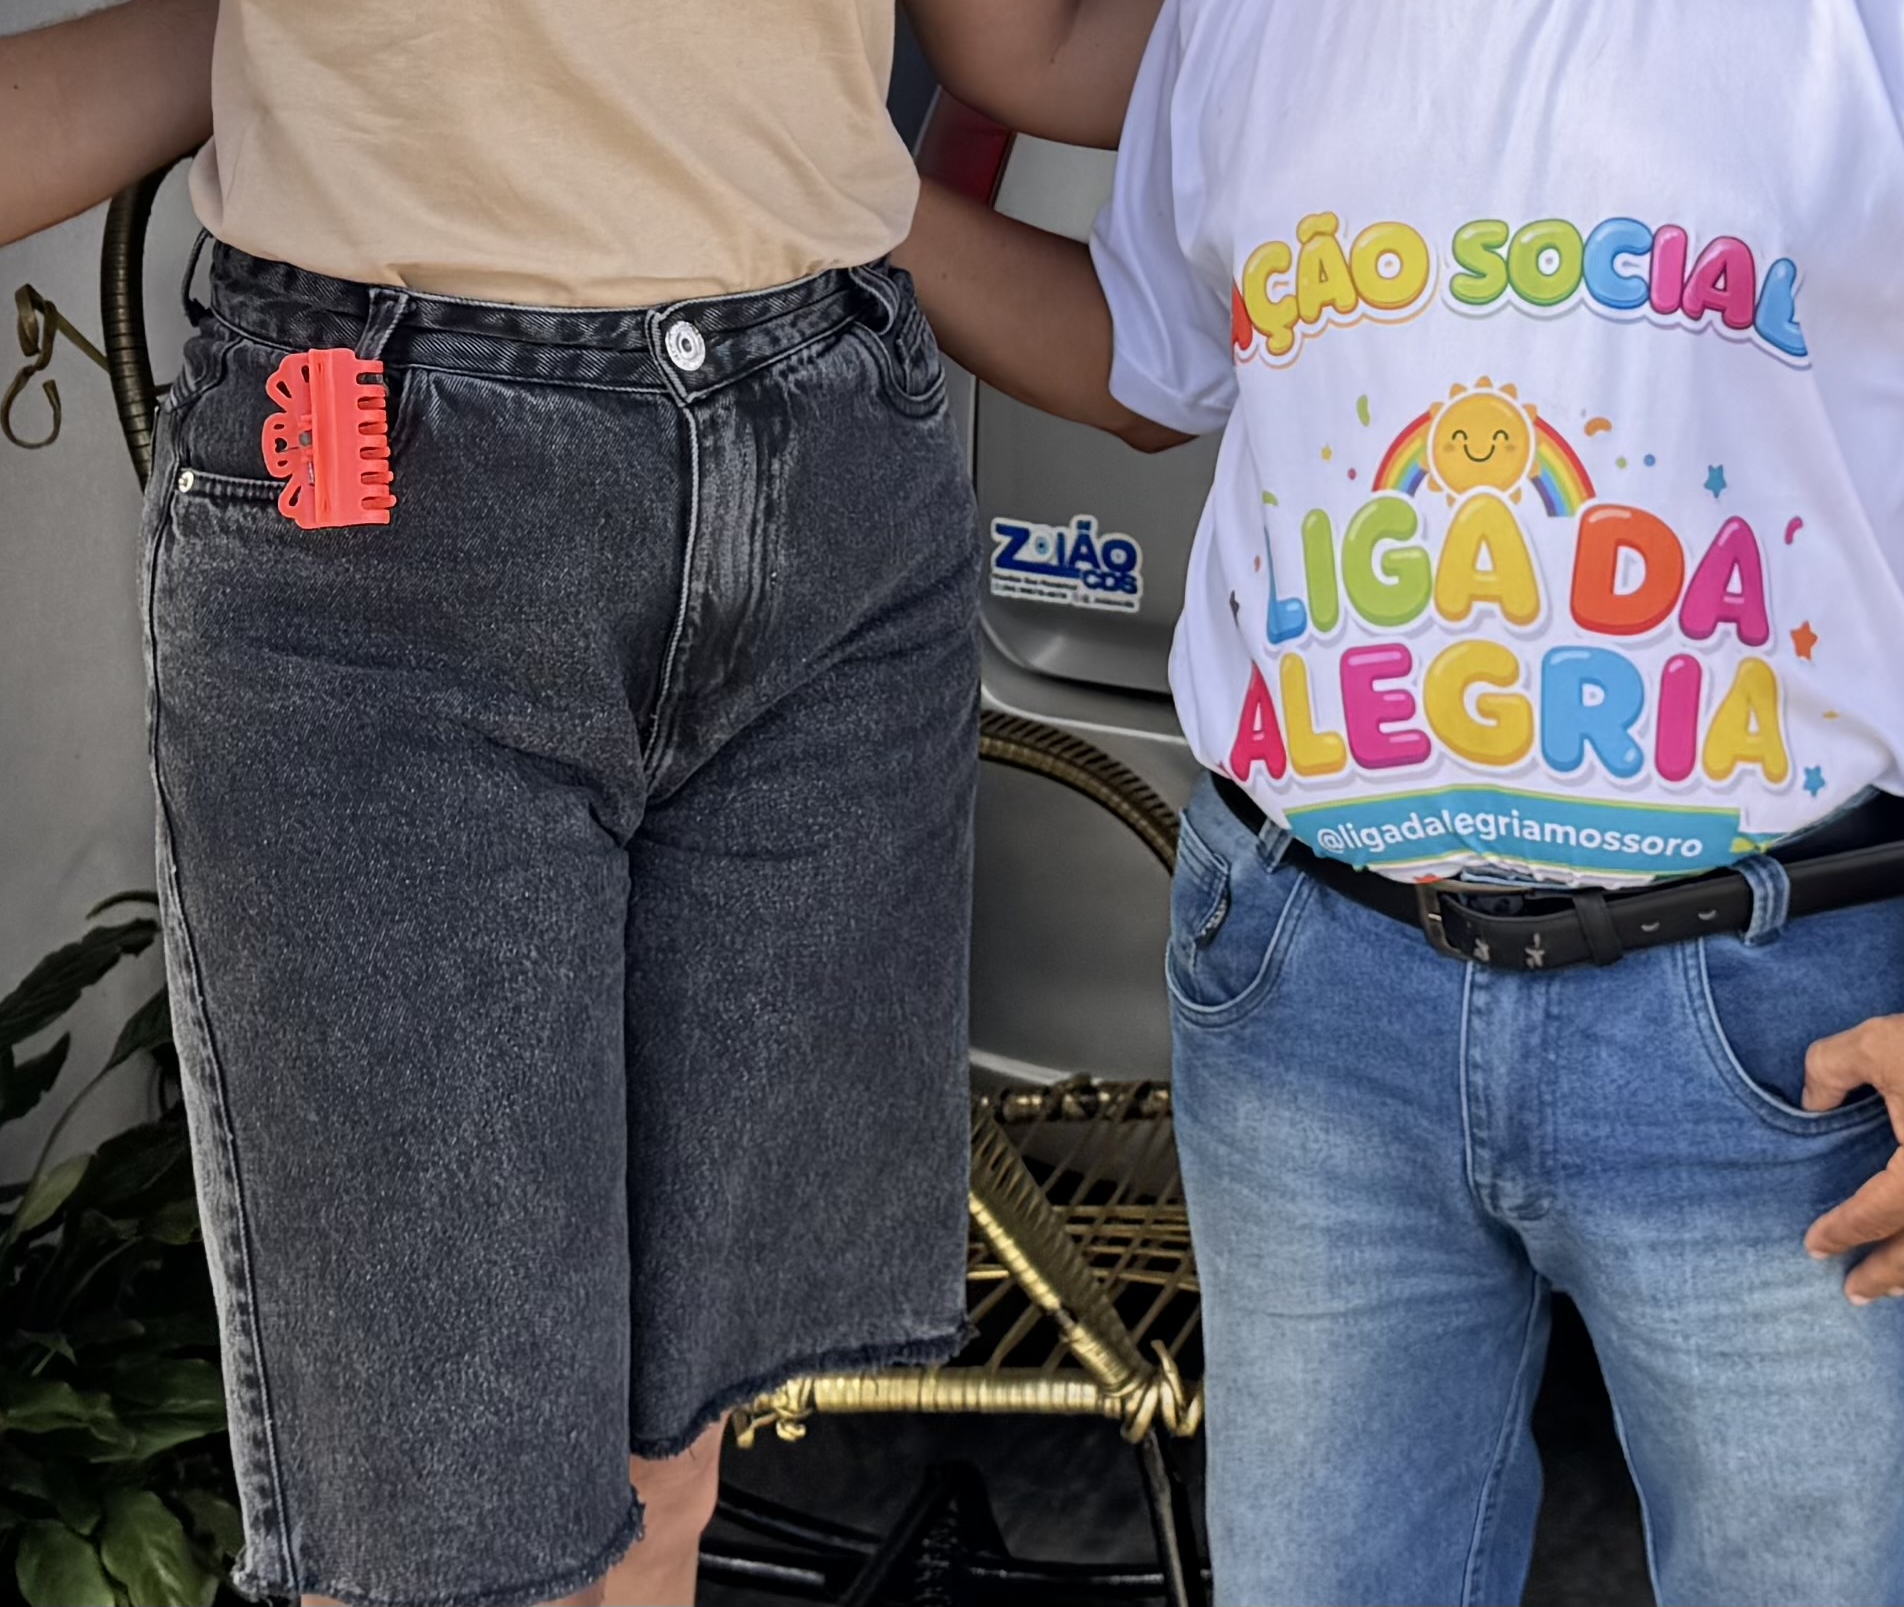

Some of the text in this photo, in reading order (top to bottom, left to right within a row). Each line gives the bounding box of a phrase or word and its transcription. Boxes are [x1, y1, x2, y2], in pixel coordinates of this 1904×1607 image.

[1449, 216, 1809, 357] SOCIAL
[1570, 503, 1770, 647] DA
[1229, 638, 1789, 784] ALEGRIA
[1317, 808, 1703, 858] @ligadalegriamossoro
